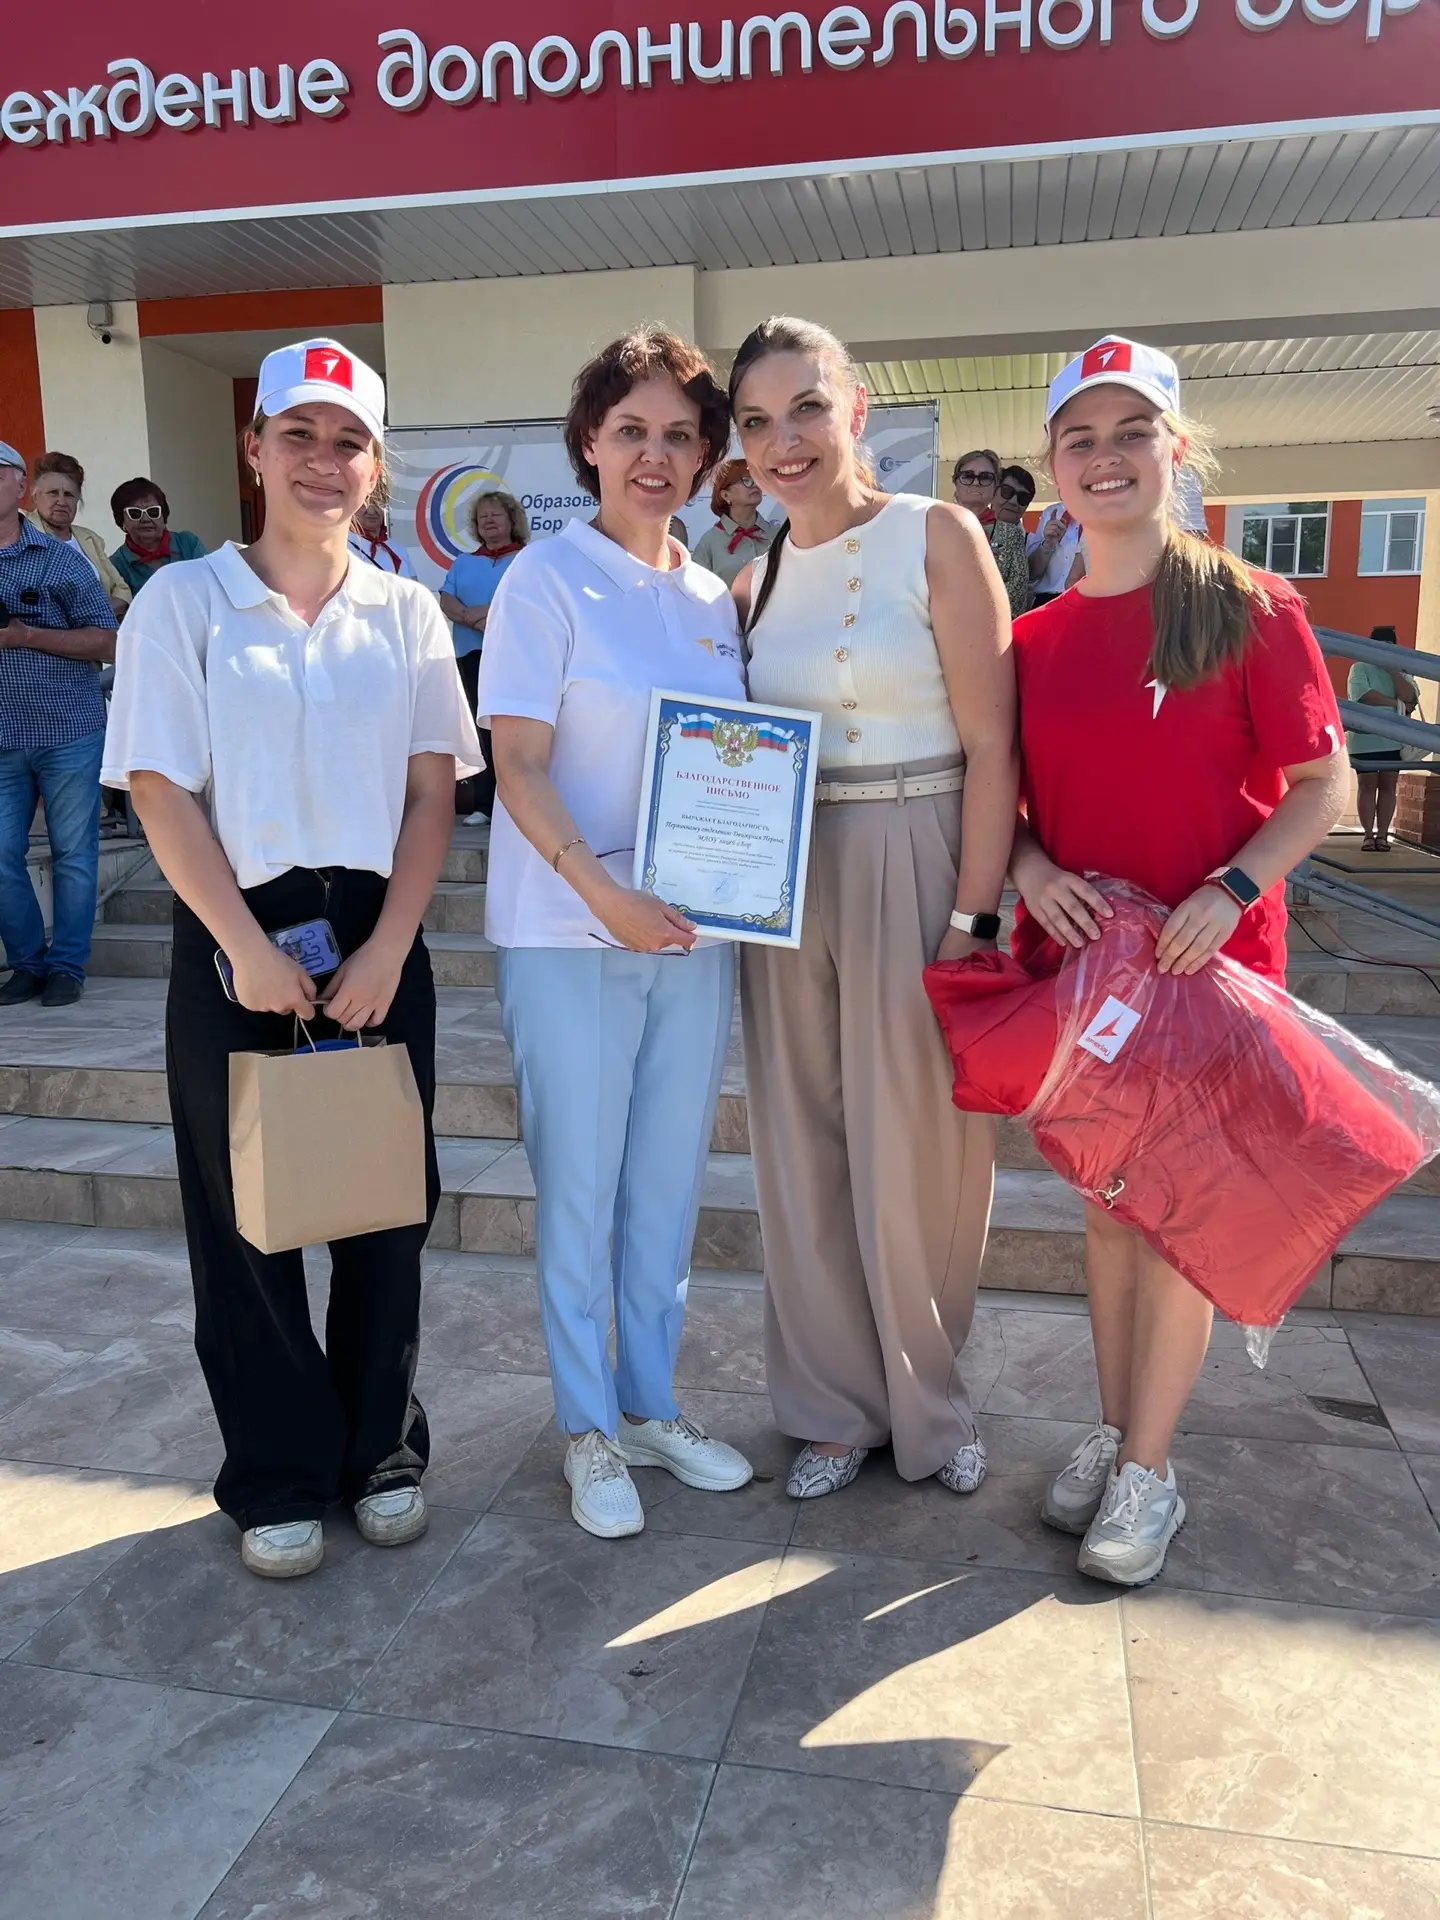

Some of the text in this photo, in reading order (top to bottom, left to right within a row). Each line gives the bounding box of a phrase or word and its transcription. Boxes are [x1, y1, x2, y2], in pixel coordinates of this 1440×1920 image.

[0, 58, 350, 145] еждение
[377, 0, 1200, 115] дополнительного
[530, 516, 563, 534] Бор
[676, 770, 781, 793] БЛАГОДАРСТВЕННОЕ
[706, 786, 750, 800] ПИСЬМО
